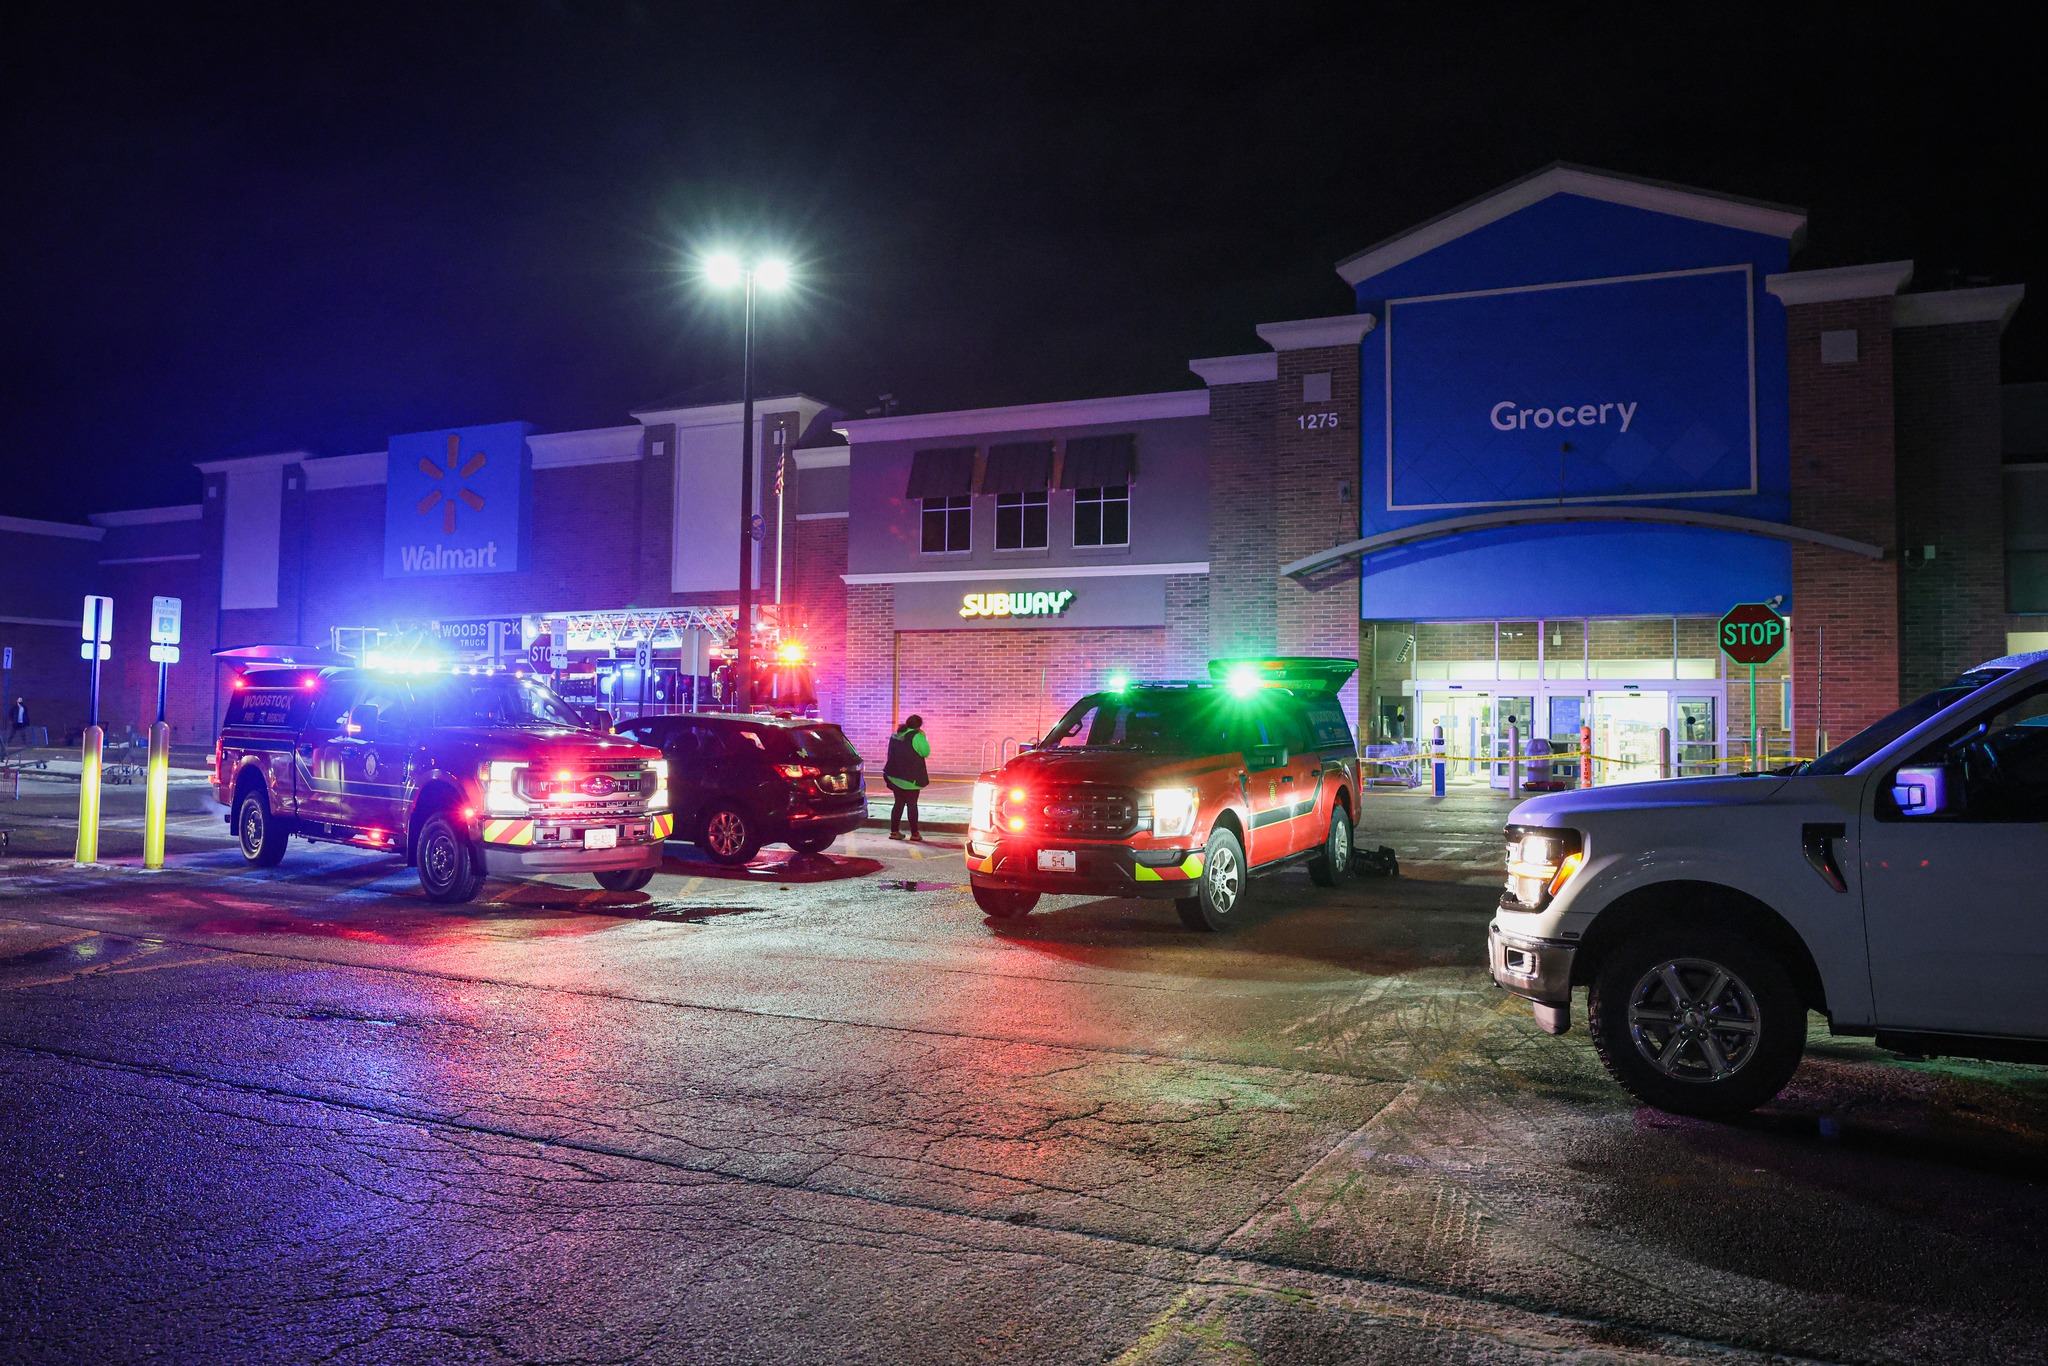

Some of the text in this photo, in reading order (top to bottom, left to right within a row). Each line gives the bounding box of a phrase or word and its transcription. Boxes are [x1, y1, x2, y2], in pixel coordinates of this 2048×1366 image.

[1298, 413, 1338, 429] 1275
[1490, 401, 1638, 433] Grocery
[401, 541, 497, 571] Walmart
[959, 589, 1074, 616] SUBWAY
[442, 622, 520, 637] WOODSCK
[1723, 622, 1781, 646] STOP
[461, 639, 486, 647] TRUCK
[5, 654, 10, 667] 7
[531, 646, 551, 662] STO
[640, 650, 646, 667] 8
[242, 694, 294, 710] WOODSTOCK
[1052, 856, 1065, 867] 5-4
